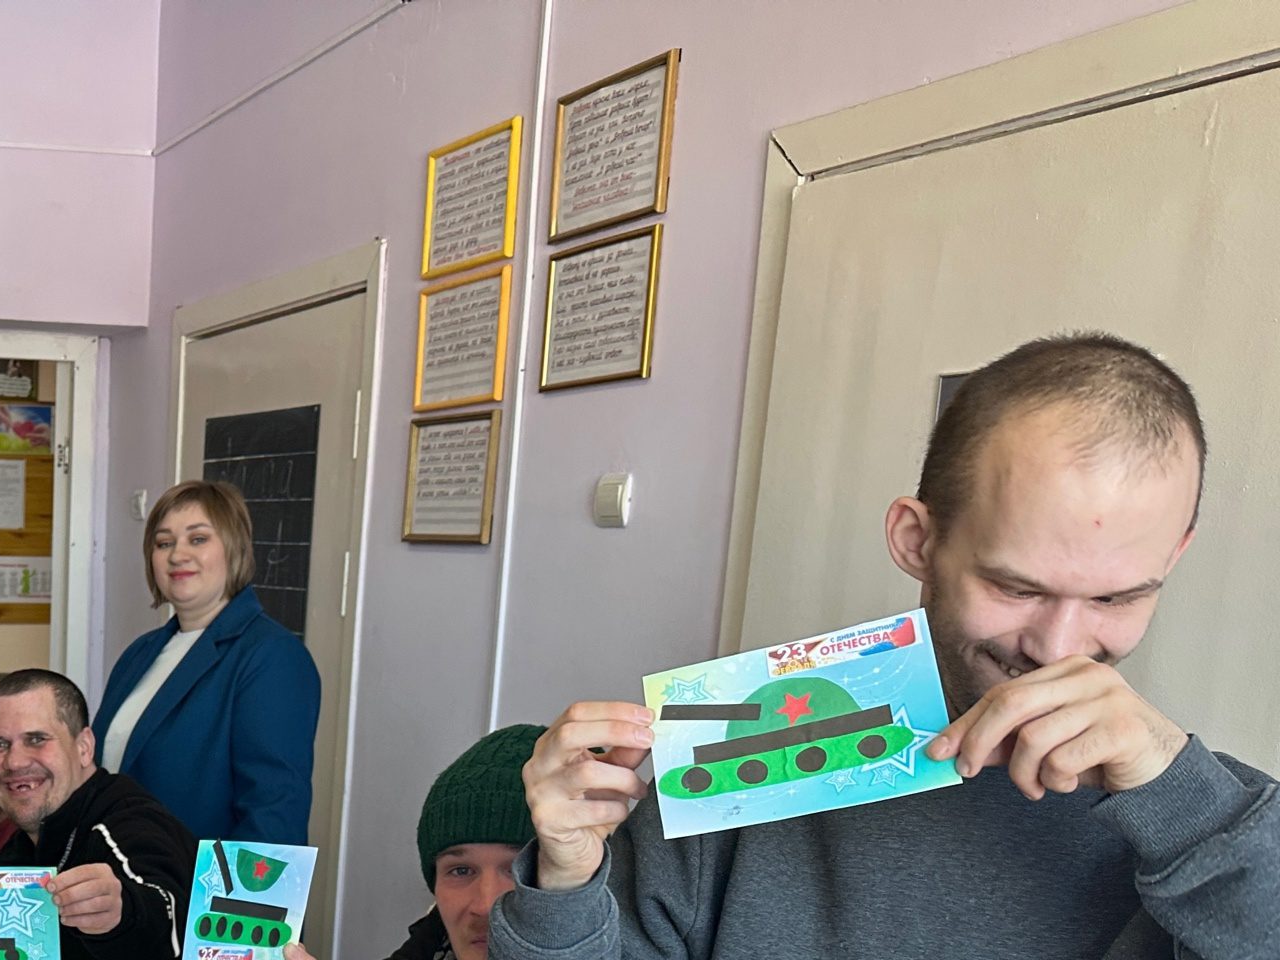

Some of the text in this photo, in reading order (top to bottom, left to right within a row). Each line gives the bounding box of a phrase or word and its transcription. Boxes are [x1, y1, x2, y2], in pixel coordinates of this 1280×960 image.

[819, 631, 891, 656] ОТЕЧЕСТВА
[836, 631, 856, 643] ДНЕМ
[776, 643, 807, 662] 23
